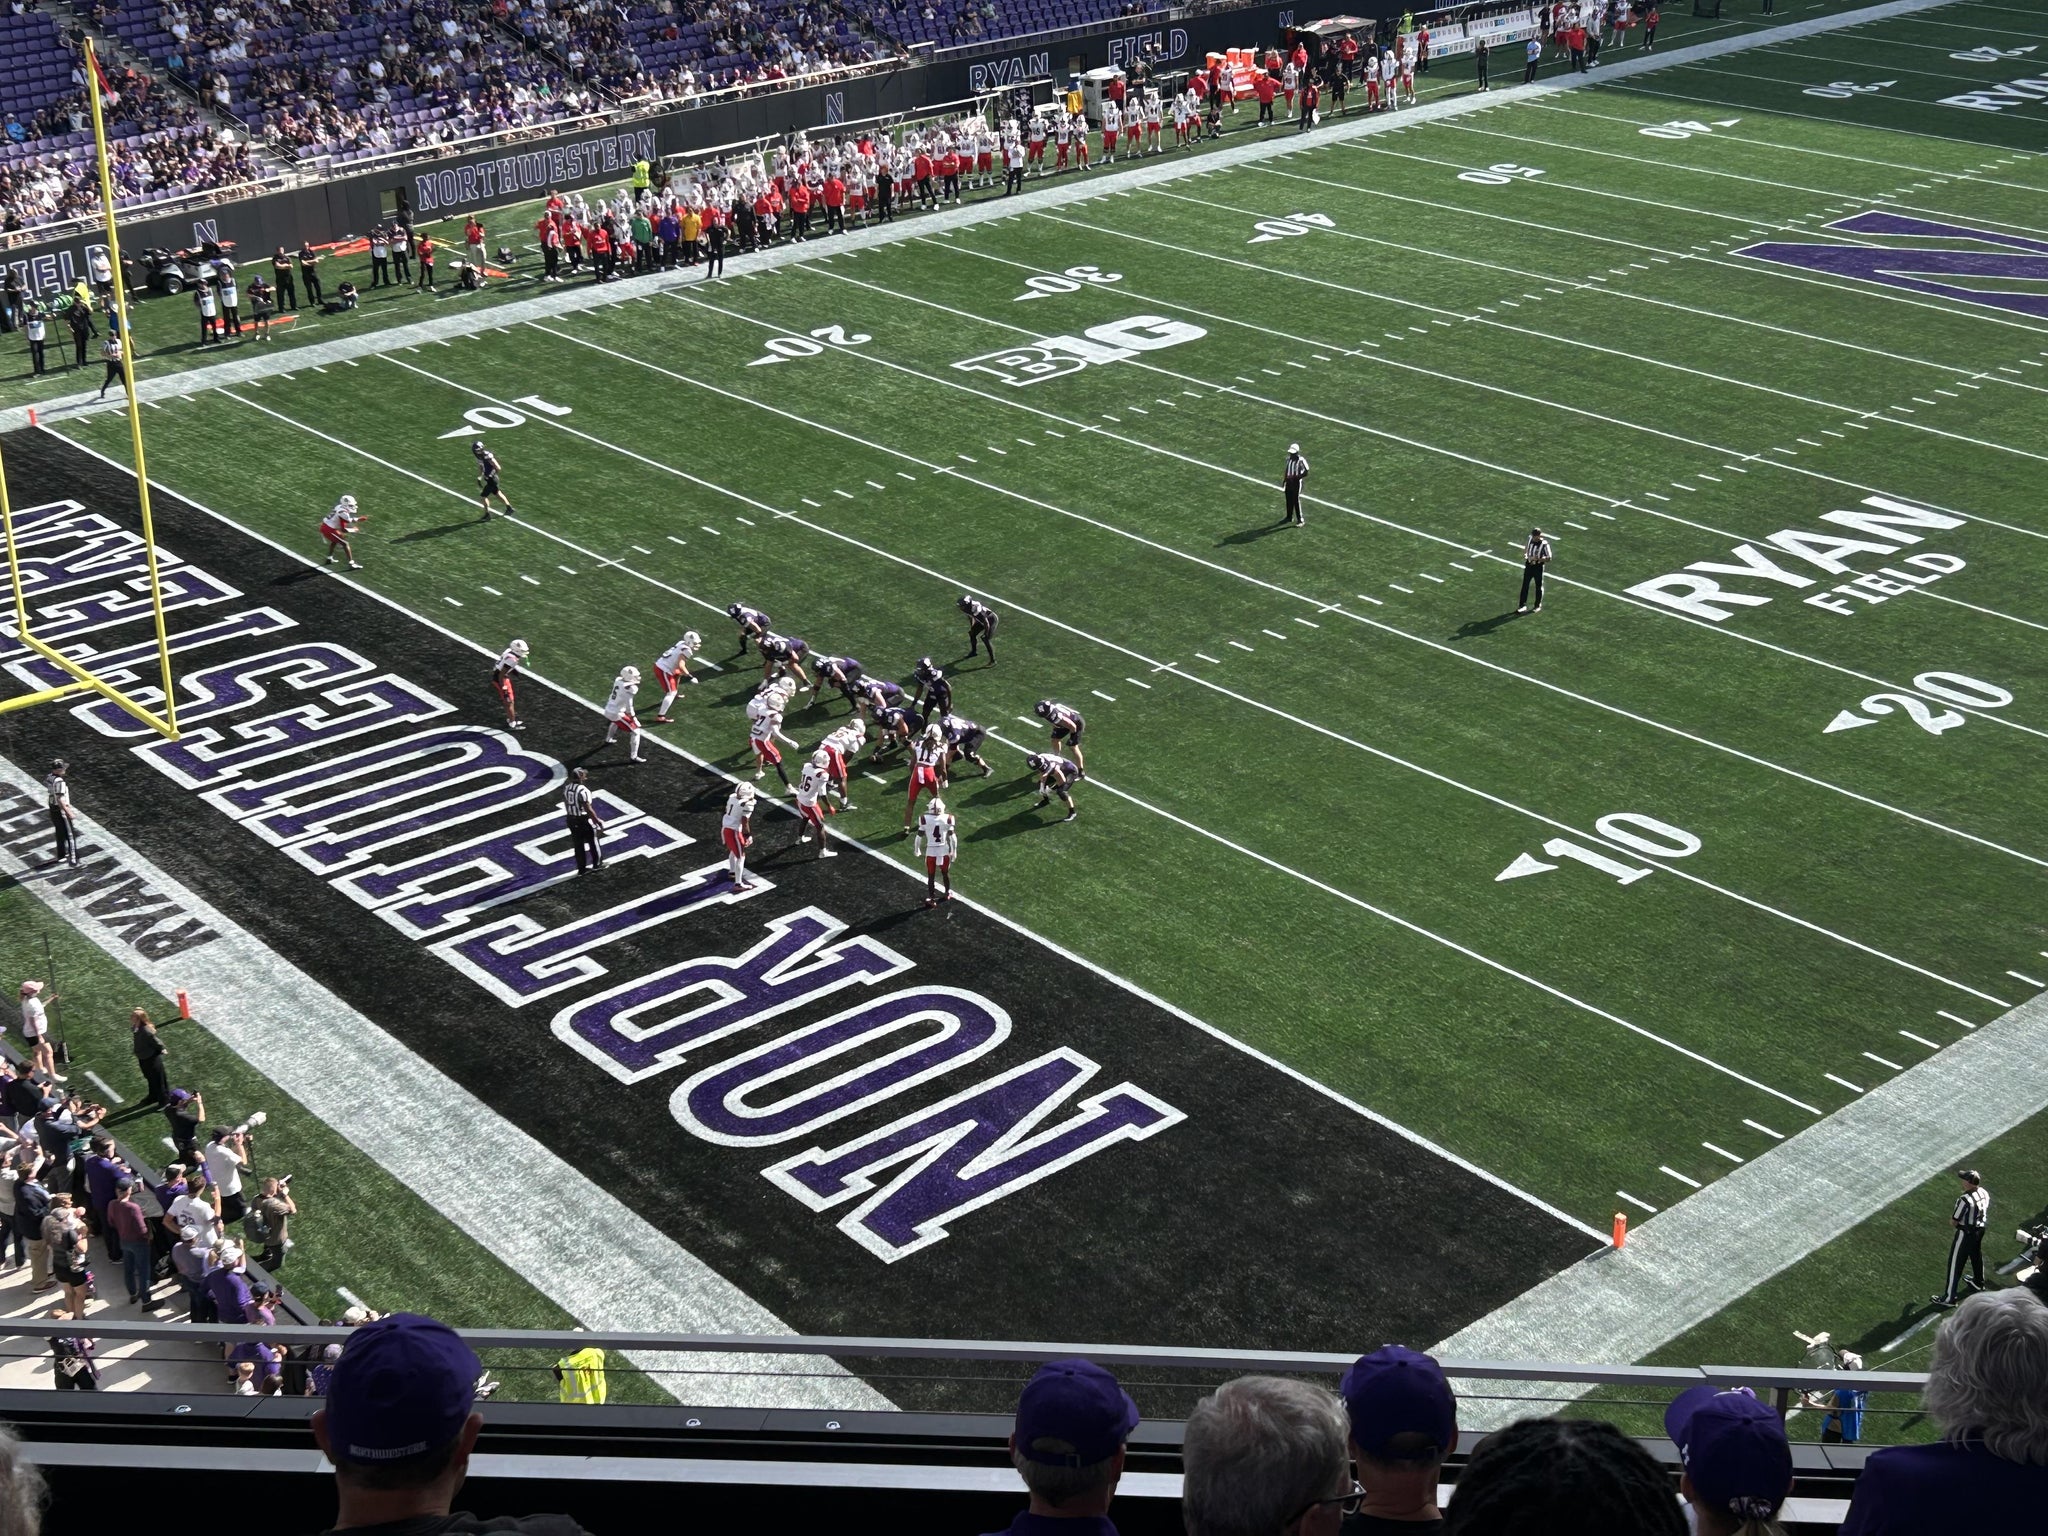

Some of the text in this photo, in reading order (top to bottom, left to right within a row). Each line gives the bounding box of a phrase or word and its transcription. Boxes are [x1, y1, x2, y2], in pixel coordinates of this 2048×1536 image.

[969, 51, 1049, 91] RYAN
[1802, 81, 1880, 98] 30
[826, 92, 844, 125] N
[1639, 120, 1712, 139] 40
[416, 128, 656, 212] NORTHWESTERN
[1457, 163, 1547, 185] 50
[1253, 213, 1336, 237] 40
[1024, 266, 1123, 293] 30
[763, 324, 873, 357] 20
[463, 395, 573, 429] 10
[1623, 496, 1967, 622] RYAN
[1803, 553, 1967, 616] FIELD
[1860, 672, 2013, 735] 20
[933, 825, 941, 843] 4
[1542, 813, 1702, 885] 10
[44, 856, 223, 962] RYAN
